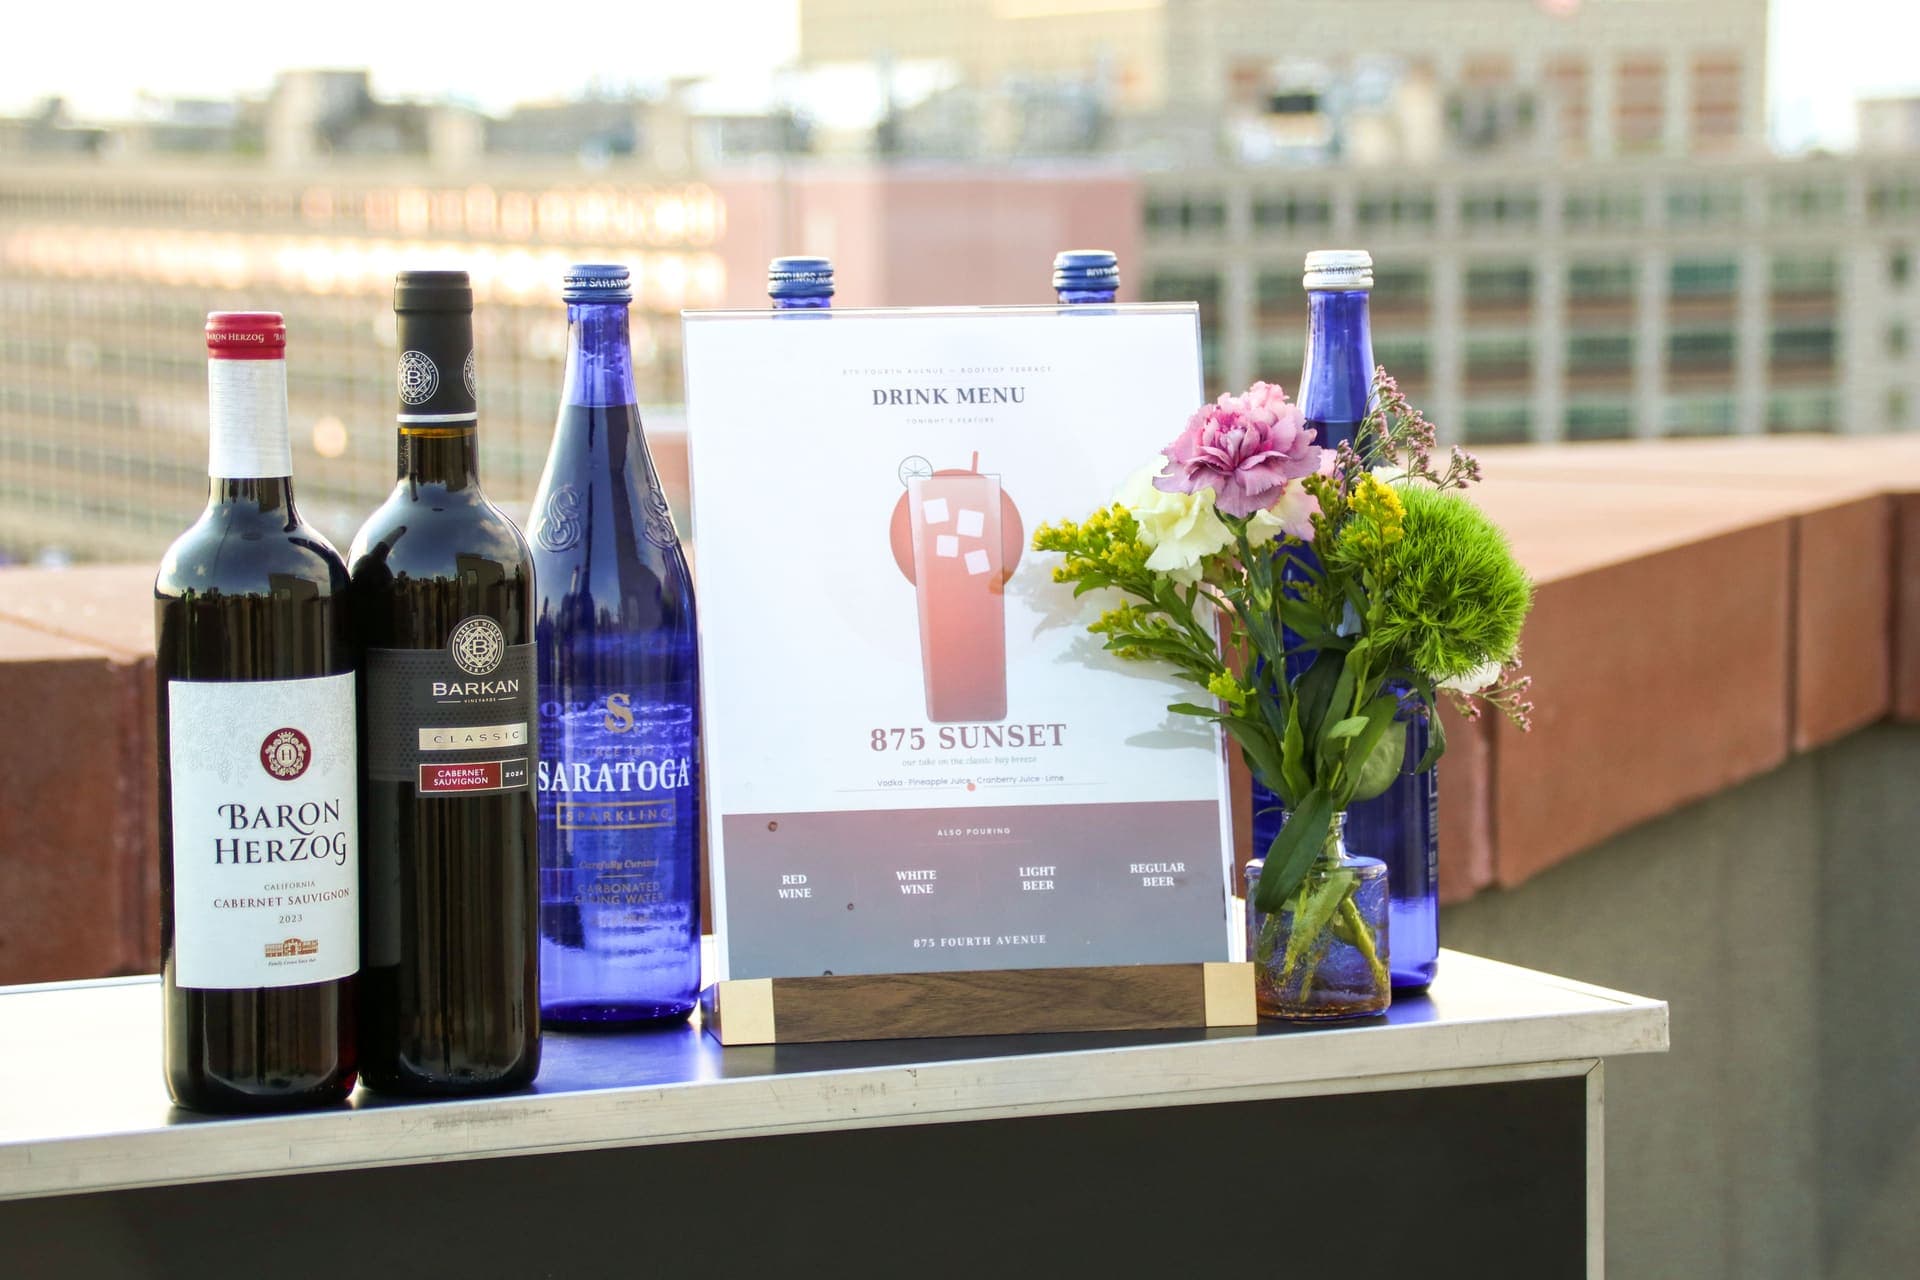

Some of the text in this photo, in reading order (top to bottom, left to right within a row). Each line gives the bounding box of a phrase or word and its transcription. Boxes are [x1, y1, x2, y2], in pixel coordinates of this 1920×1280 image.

[228, 332, 265, 343] HERZOG
[907, 367, 944, 375] AVENUE
[407, 370, 420, 385] B
[872, 386, 1025, 406] DRINK MENU
[957, 416, 995, 424] FEATURE
[473, 640, 488, 655] B
[464, 662, 496, 674] ISRAEL
[432, 679, 519, 696] BARKAN
[434, 731, 519, 744] CLASSIC
[870, 723, 1067, 751] 875 SUNSET
[918, 757, 936, 766] take
[950, 757, 963, 766] the
[438, 768, 484, 778] CABERNET
[538, 758, 689, 792] SARATOGA
[434, 776, 488, 787] SAUVIGNON
[877, 774, 1064, 787] Vodka Pineapple Juice Cranberry Juice Lime
[218, 798, 340, 836] BARON
[567, 809, 670, 822] SPARKLING
[937, 827, 1011, 837] ALSO POURING
[214, 831, 347, 866] HERZOG
[1019, 866, 1056, 877] LIGHT
[1130, 862, 1186, 874] REGULAR
[782, 874, 807, 885] RED
[896, 870, 937, 881] WHITE
[1143, 876, 1175, 887] BEER
[264, 880, 316, 891] CALIFORNIA
[577, 882, 661, 894] CARBONATED
[901, 884, 934, 895] WINE
[1023, 880, 1055, 891] BEER
[214, 887, 350, 909] CABERNET SAUVIGNON
[575, 893, 664, 905] SPRING WATER
[778, 888, 812, 899] WINE
[279, 914, 303, 924] 2023
[913, 934, 1047, 948] 875 FOURTH AVENUE
